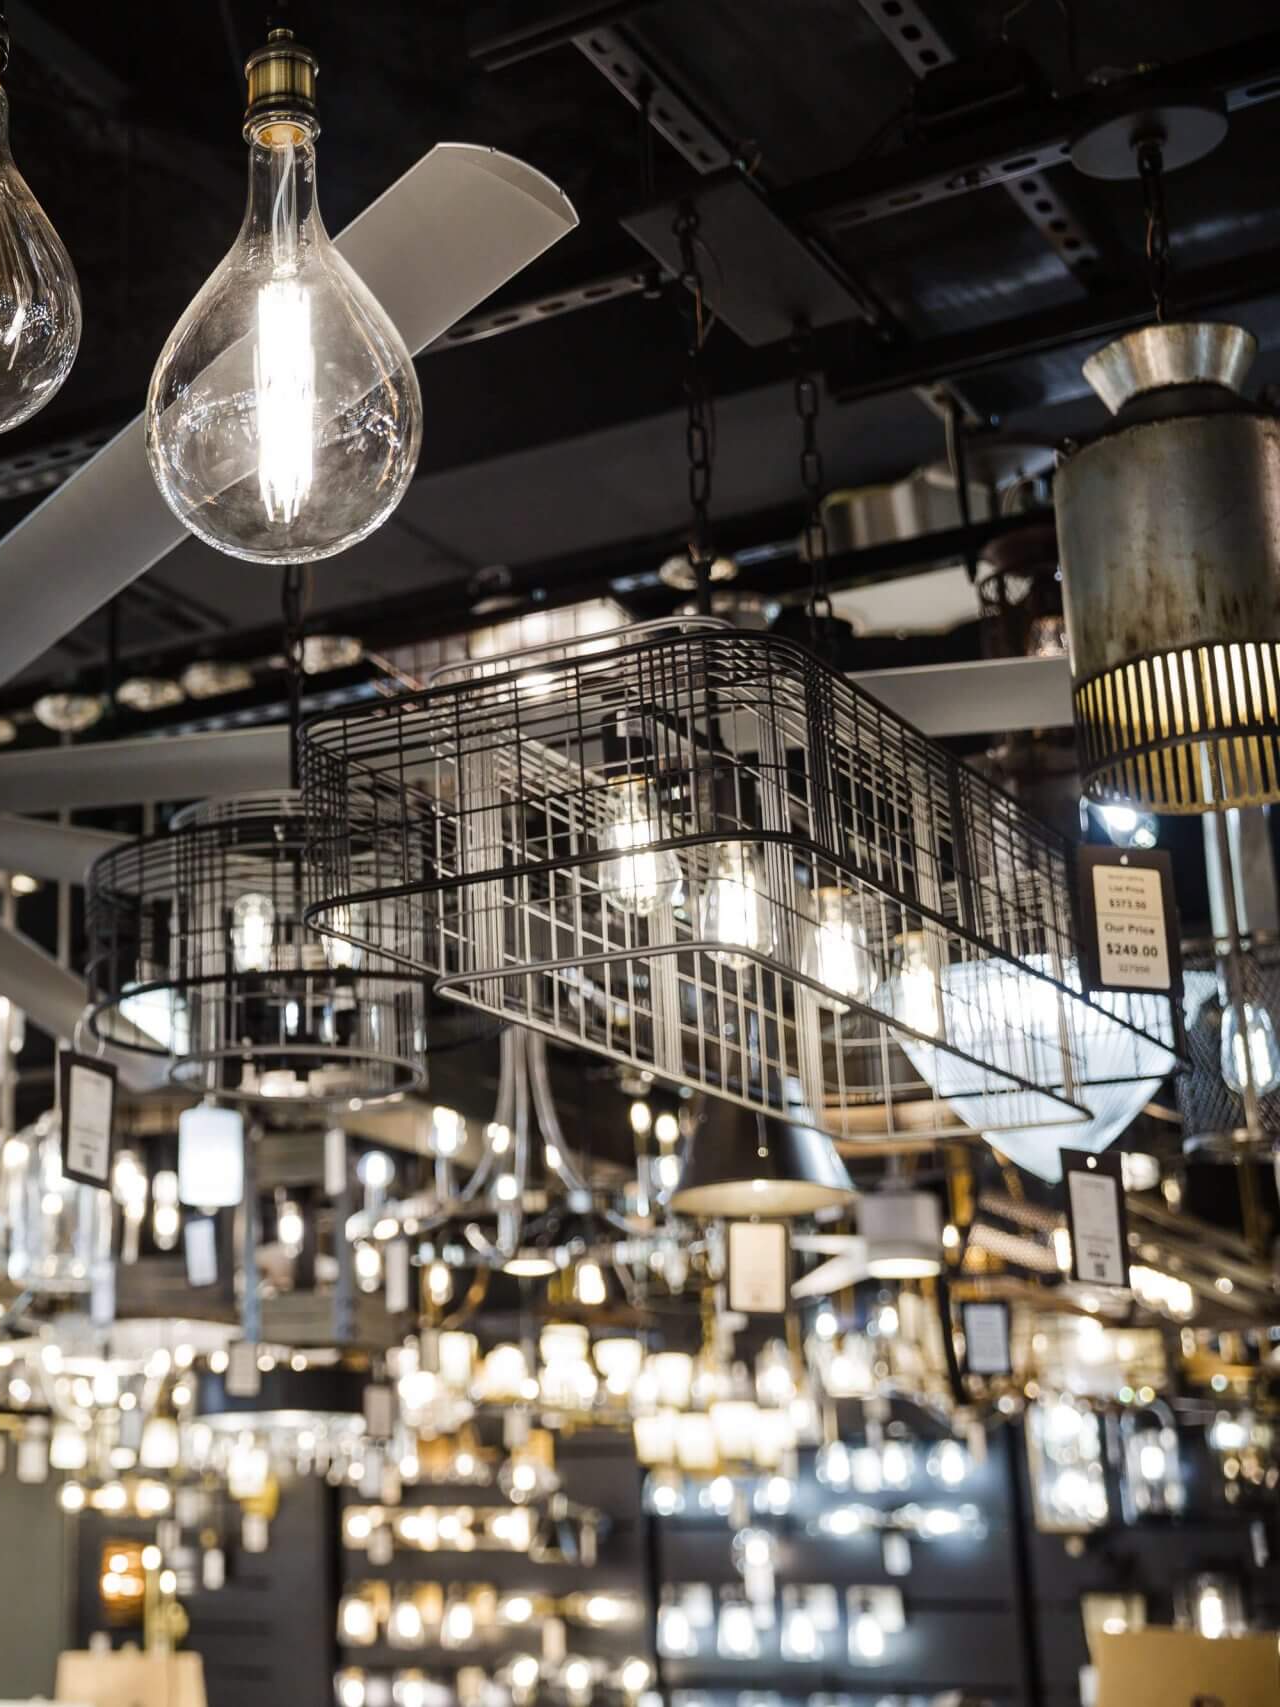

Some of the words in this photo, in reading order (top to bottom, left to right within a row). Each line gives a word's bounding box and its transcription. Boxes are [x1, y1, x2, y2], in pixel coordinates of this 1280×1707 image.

[1125, 885, 1145, 895] Price
[1104, 922, 1124, 933] Our
[1128, 923, 1155, 936] Price
[1106, 943, 1158, 958] $249.00
